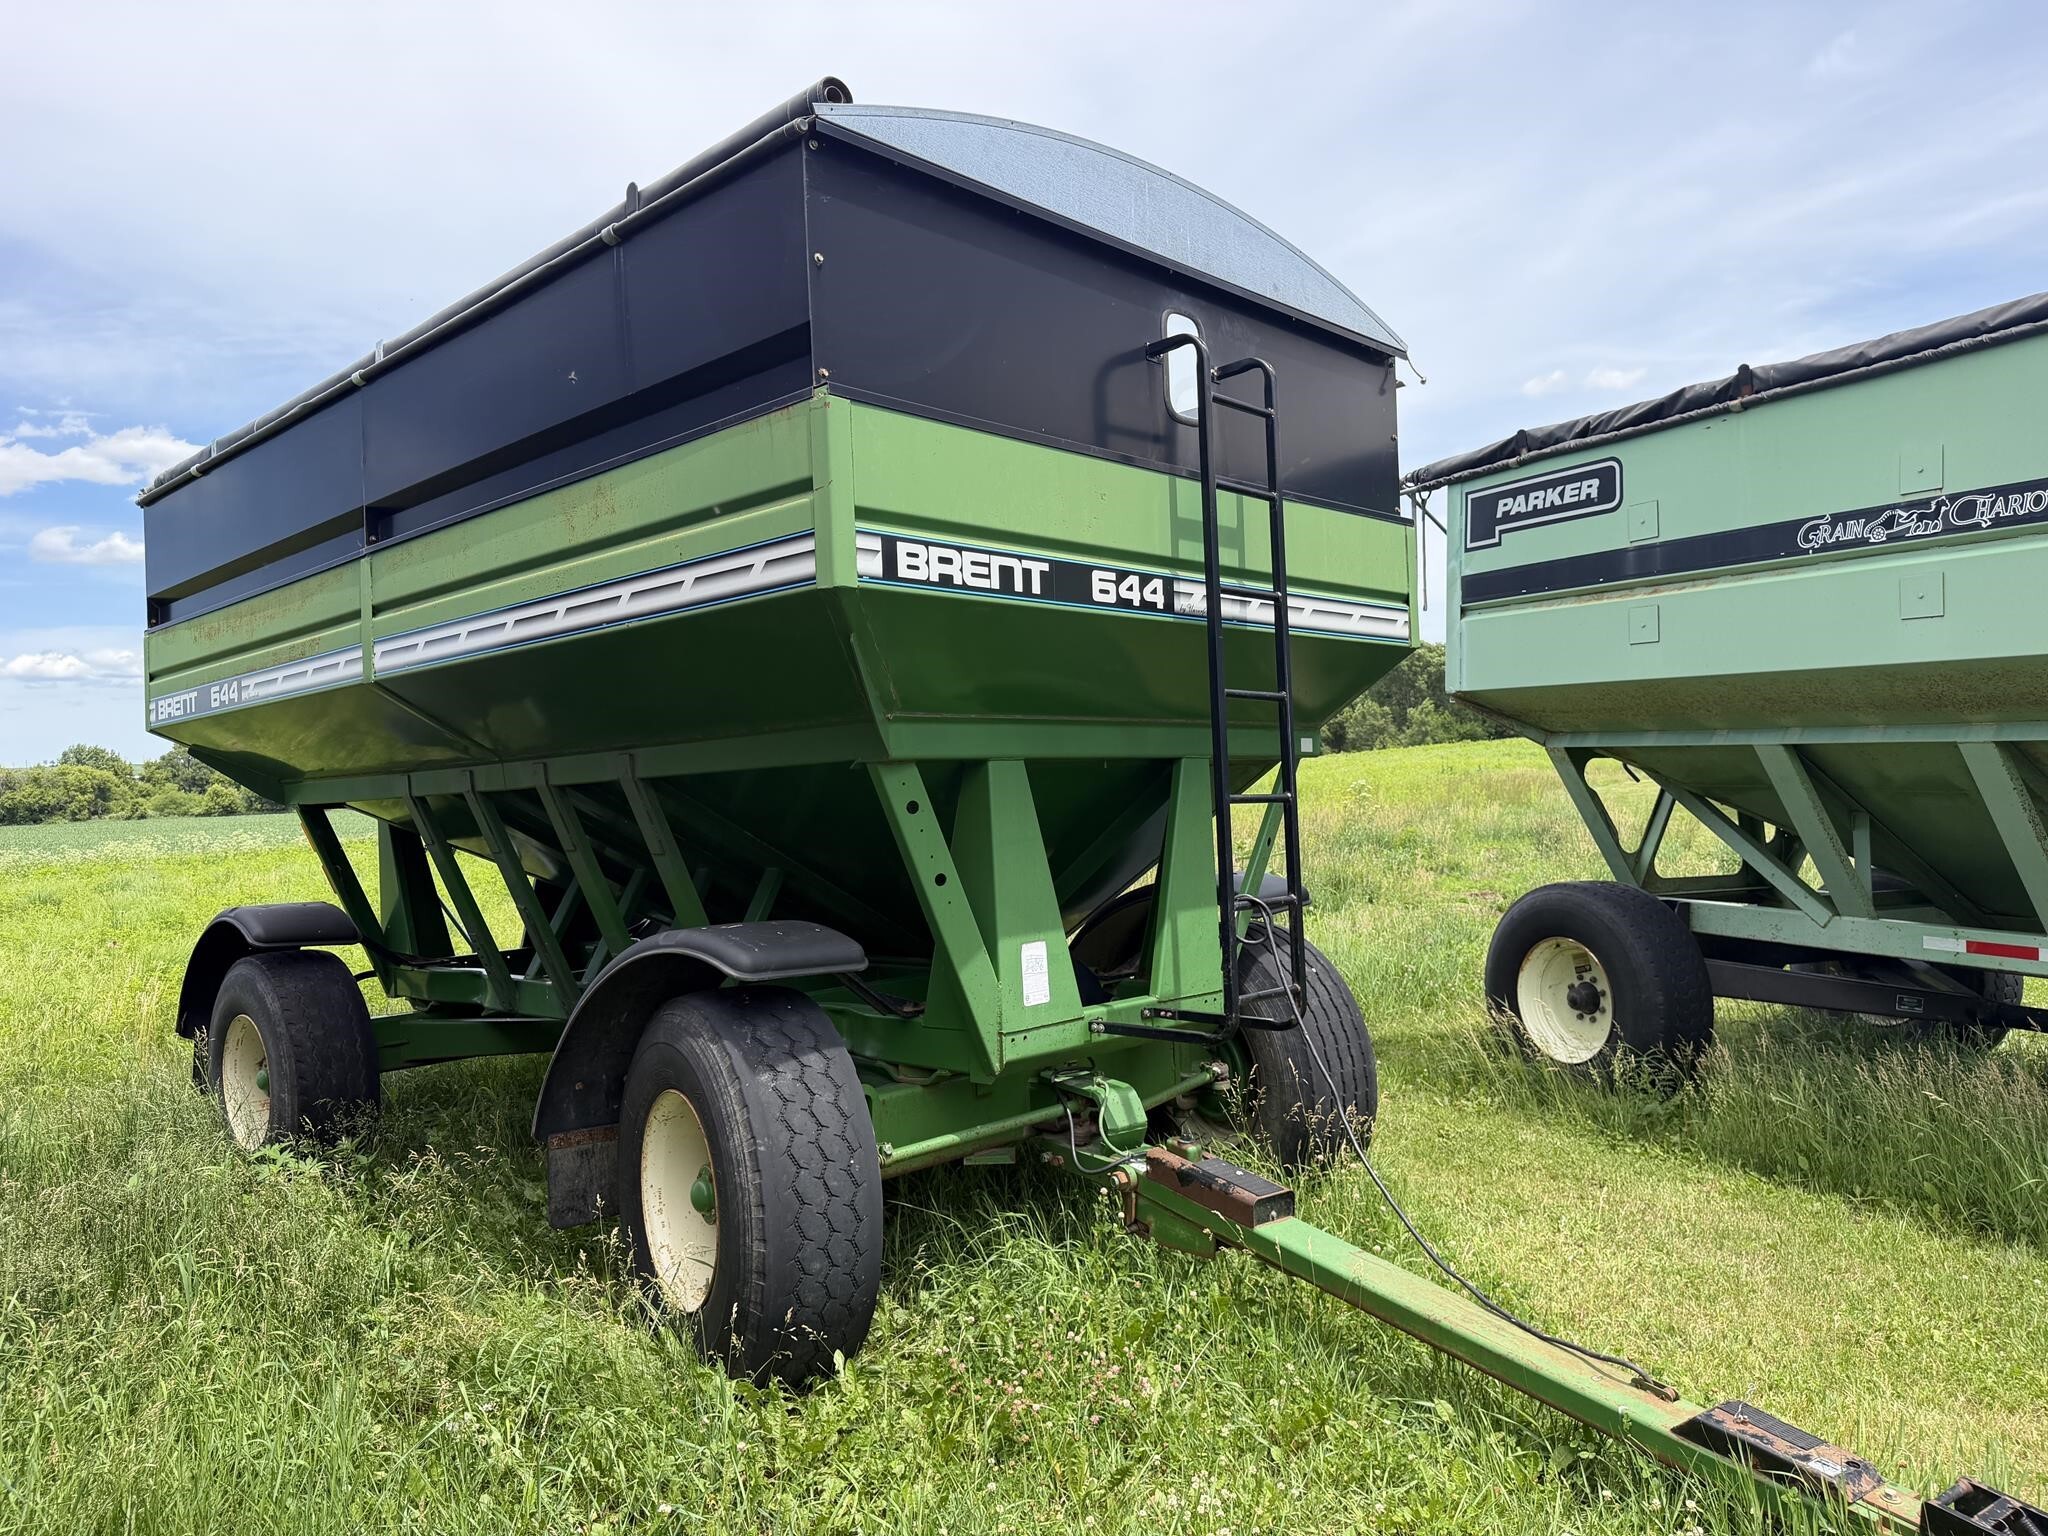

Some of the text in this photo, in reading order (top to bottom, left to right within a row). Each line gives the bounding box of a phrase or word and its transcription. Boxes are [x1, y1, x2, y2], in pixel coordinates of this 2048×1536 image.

[1496, 478, 1600, 519] PARKER
[1797, 490, 2048, 549] GRAIN CHARIO
[896, 541, 1165, 610] BRENT 644
[157, 691, 198, 721] BRENT
[210, 680, 239, 709] 644
